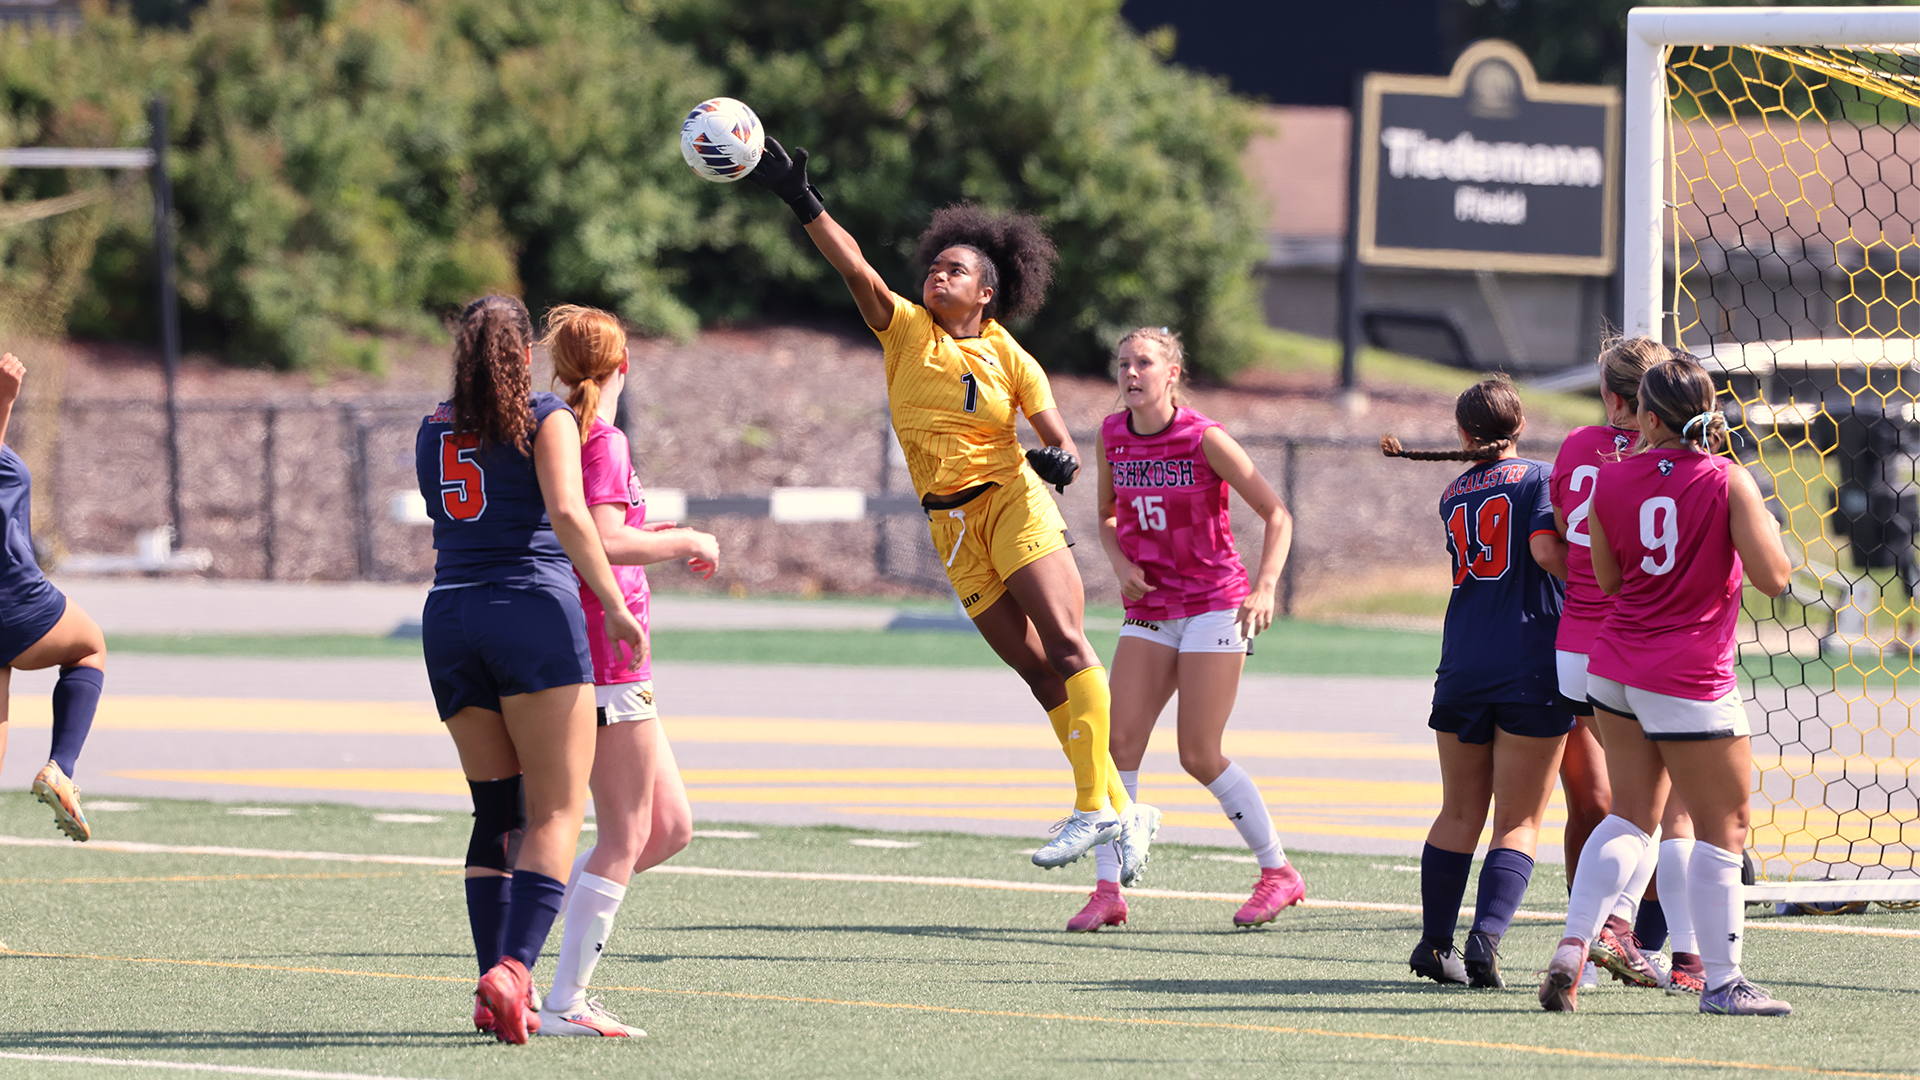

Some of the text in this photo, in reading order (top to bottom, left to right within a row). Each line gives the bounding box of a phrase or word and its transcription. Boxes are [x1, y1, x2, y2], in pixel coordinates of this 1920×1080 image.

[1381, 126, 1602, 187] Tiedemann
[1454, 186, 1527, 225] Field
[961, 371, 978, 413] 1
[440, 430, 487, 522] 5
[1109, 460, 1195, 488] SHKOSH
[1131, 495, 1167, 531] 15
[1639, 496, 1678, 576] 9
[1447, 493, 1512, 589] 19
